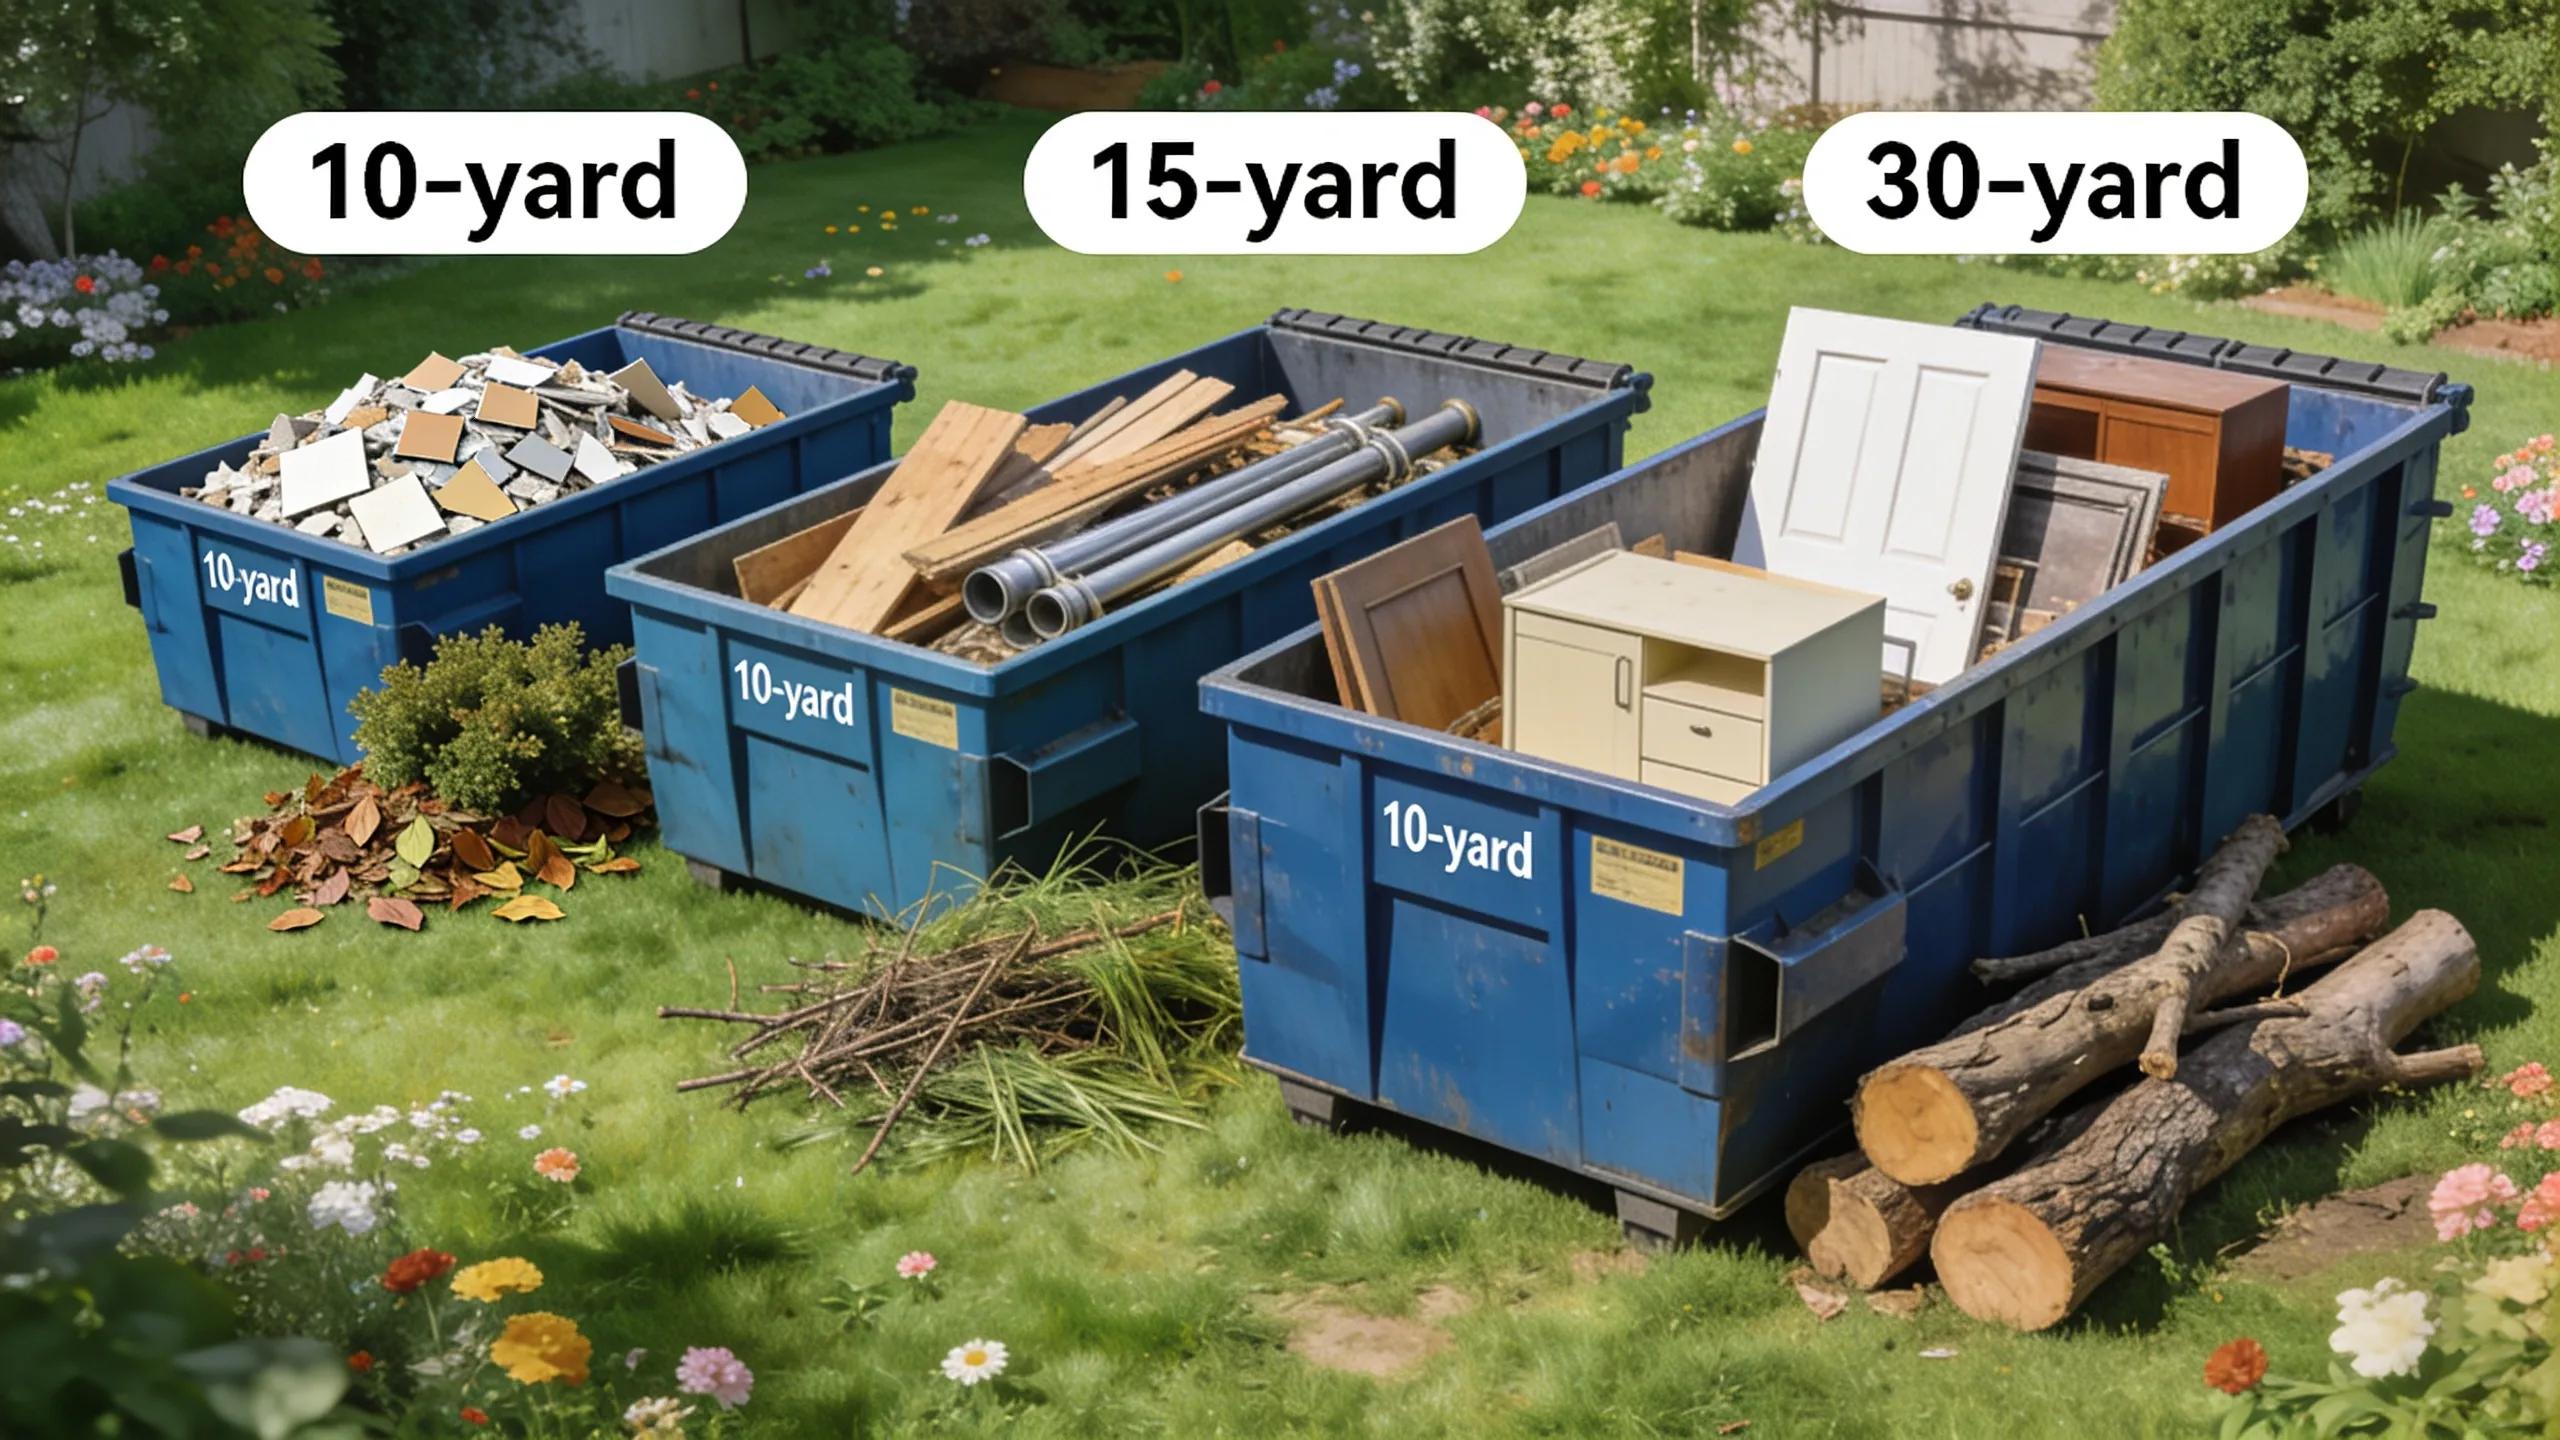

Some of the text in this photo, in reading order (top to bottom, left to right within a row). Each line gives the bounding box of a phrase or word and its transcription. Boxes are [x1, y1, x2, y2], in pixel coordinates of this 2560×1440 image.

[202, 550, 300, 609] 10-yard
[733, 659, 854, 727] 10-yard
[1382, 800, 1533, 880] 10-yard
